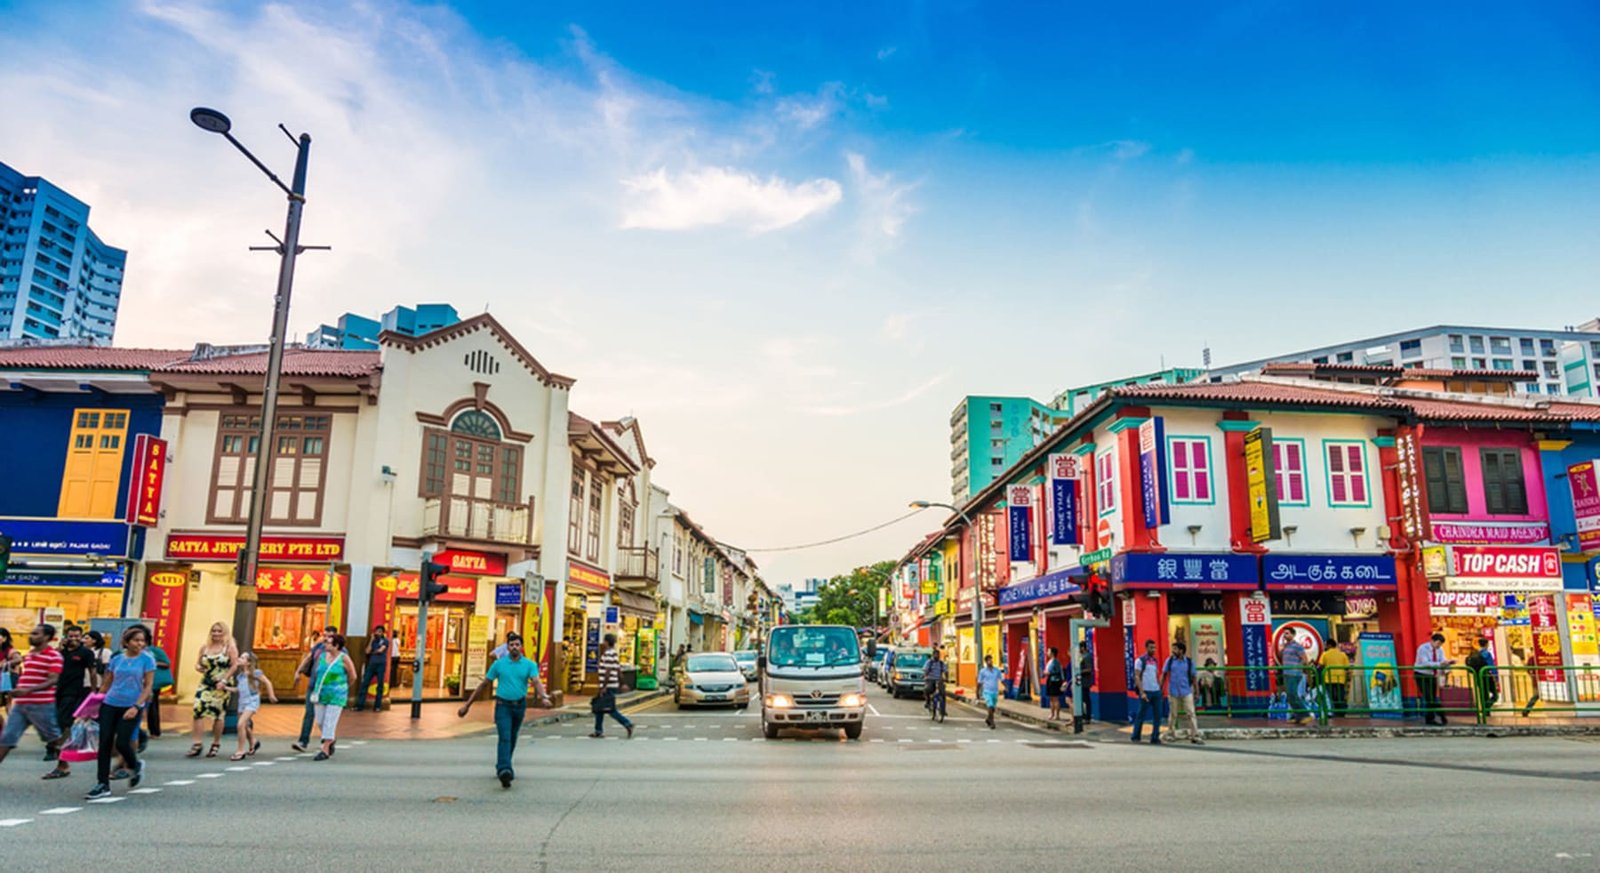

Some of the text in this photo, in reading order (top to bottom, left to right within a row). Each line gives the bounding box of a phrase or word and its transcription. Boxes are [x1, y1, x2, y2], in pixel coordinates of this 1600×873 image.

[144, 443, 160, 513] SATYA
[1056, 484, 1066, 540] MONEYMAX
[1012, 511, 1021, 558] MONEYMAX
[170, 542, 341, 555] SATYA JEWEERY PTE LTD
[452, 555, 486, 570] SATYA
[1462, 553, 1541, 573] TOP CASH
[1283, 599, 1323, 611] MAX
[1434, 591, 1487, 606] TOP CASH
[157, 588, 170, 648] JEWELL
